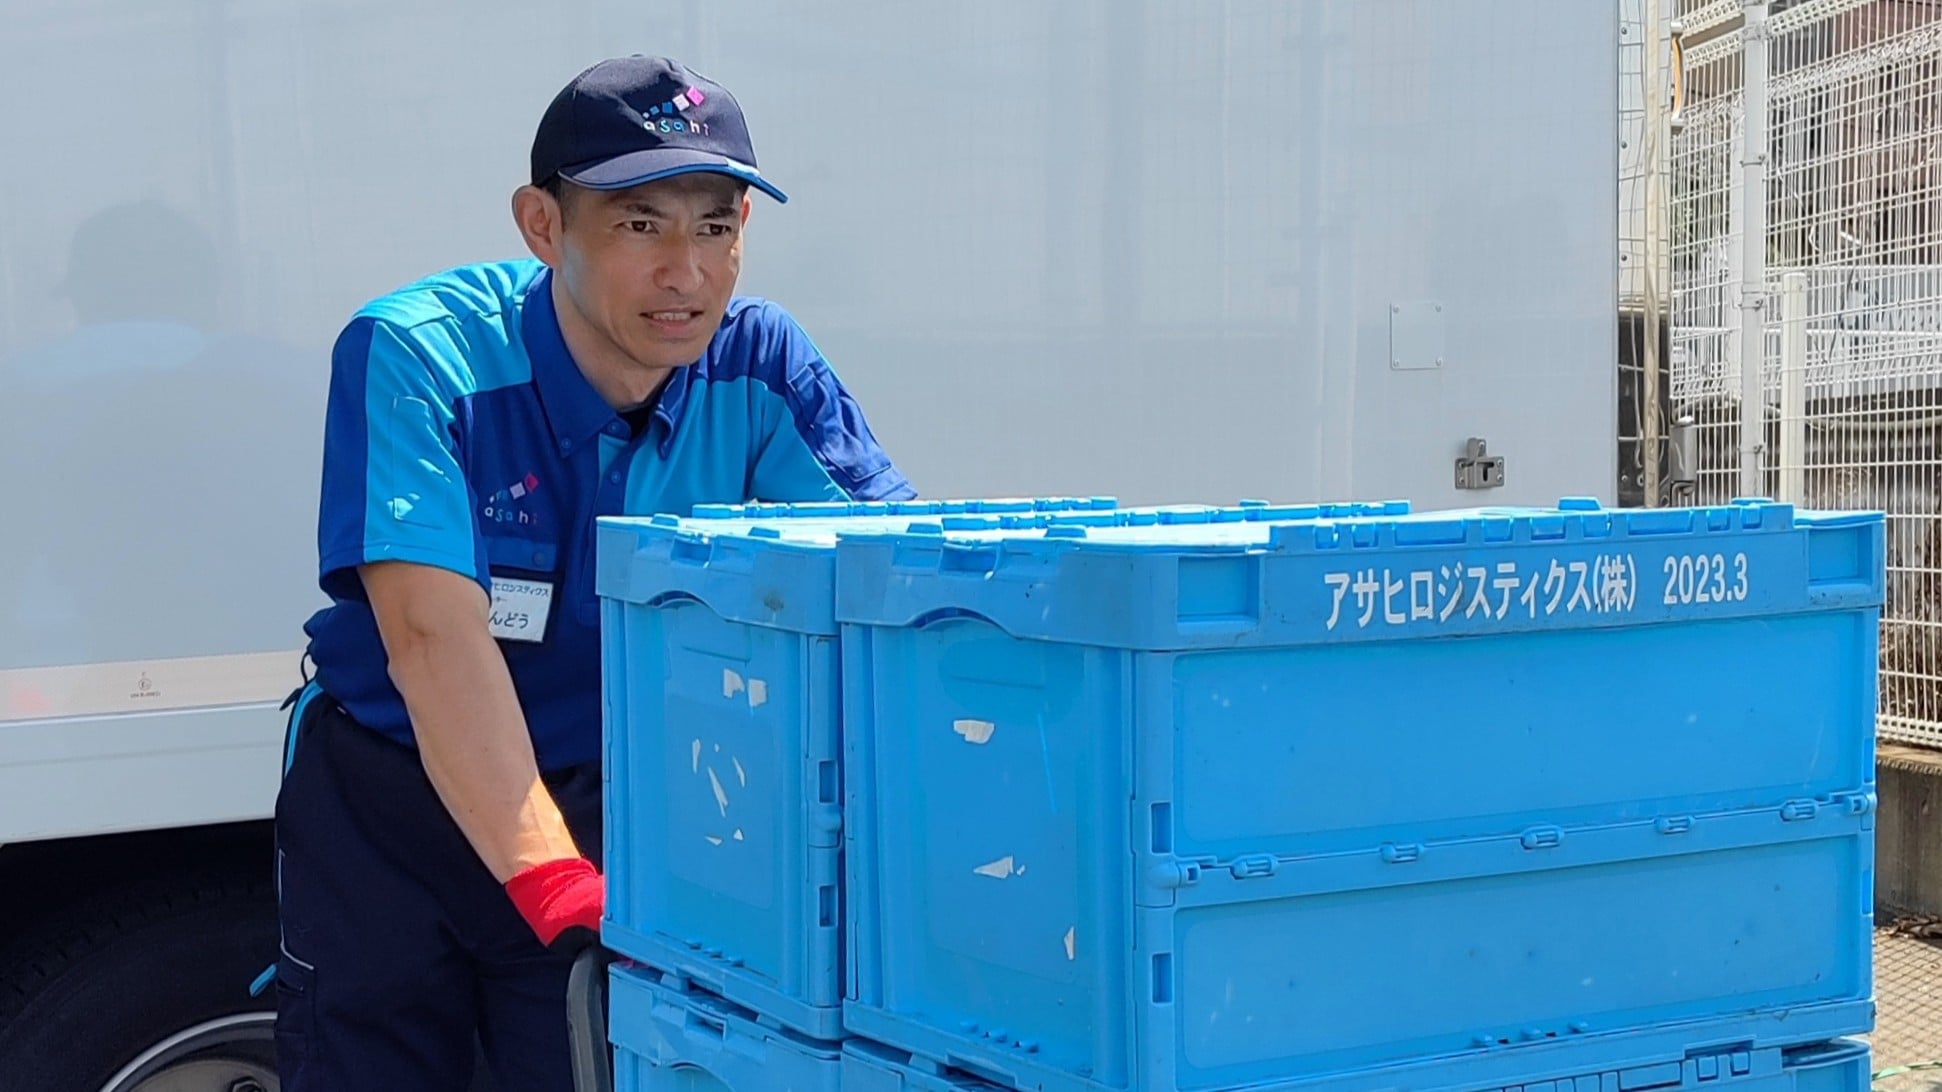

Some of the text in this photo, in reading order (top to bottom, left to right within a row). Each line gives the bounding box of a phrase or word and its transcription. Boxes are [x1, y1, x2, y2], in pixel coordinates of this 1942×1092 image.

[643, 119, 709, 137] asahi
[484, 506, 538, 525] asahi
[1662, 551, 1749, 606] 2023.3
